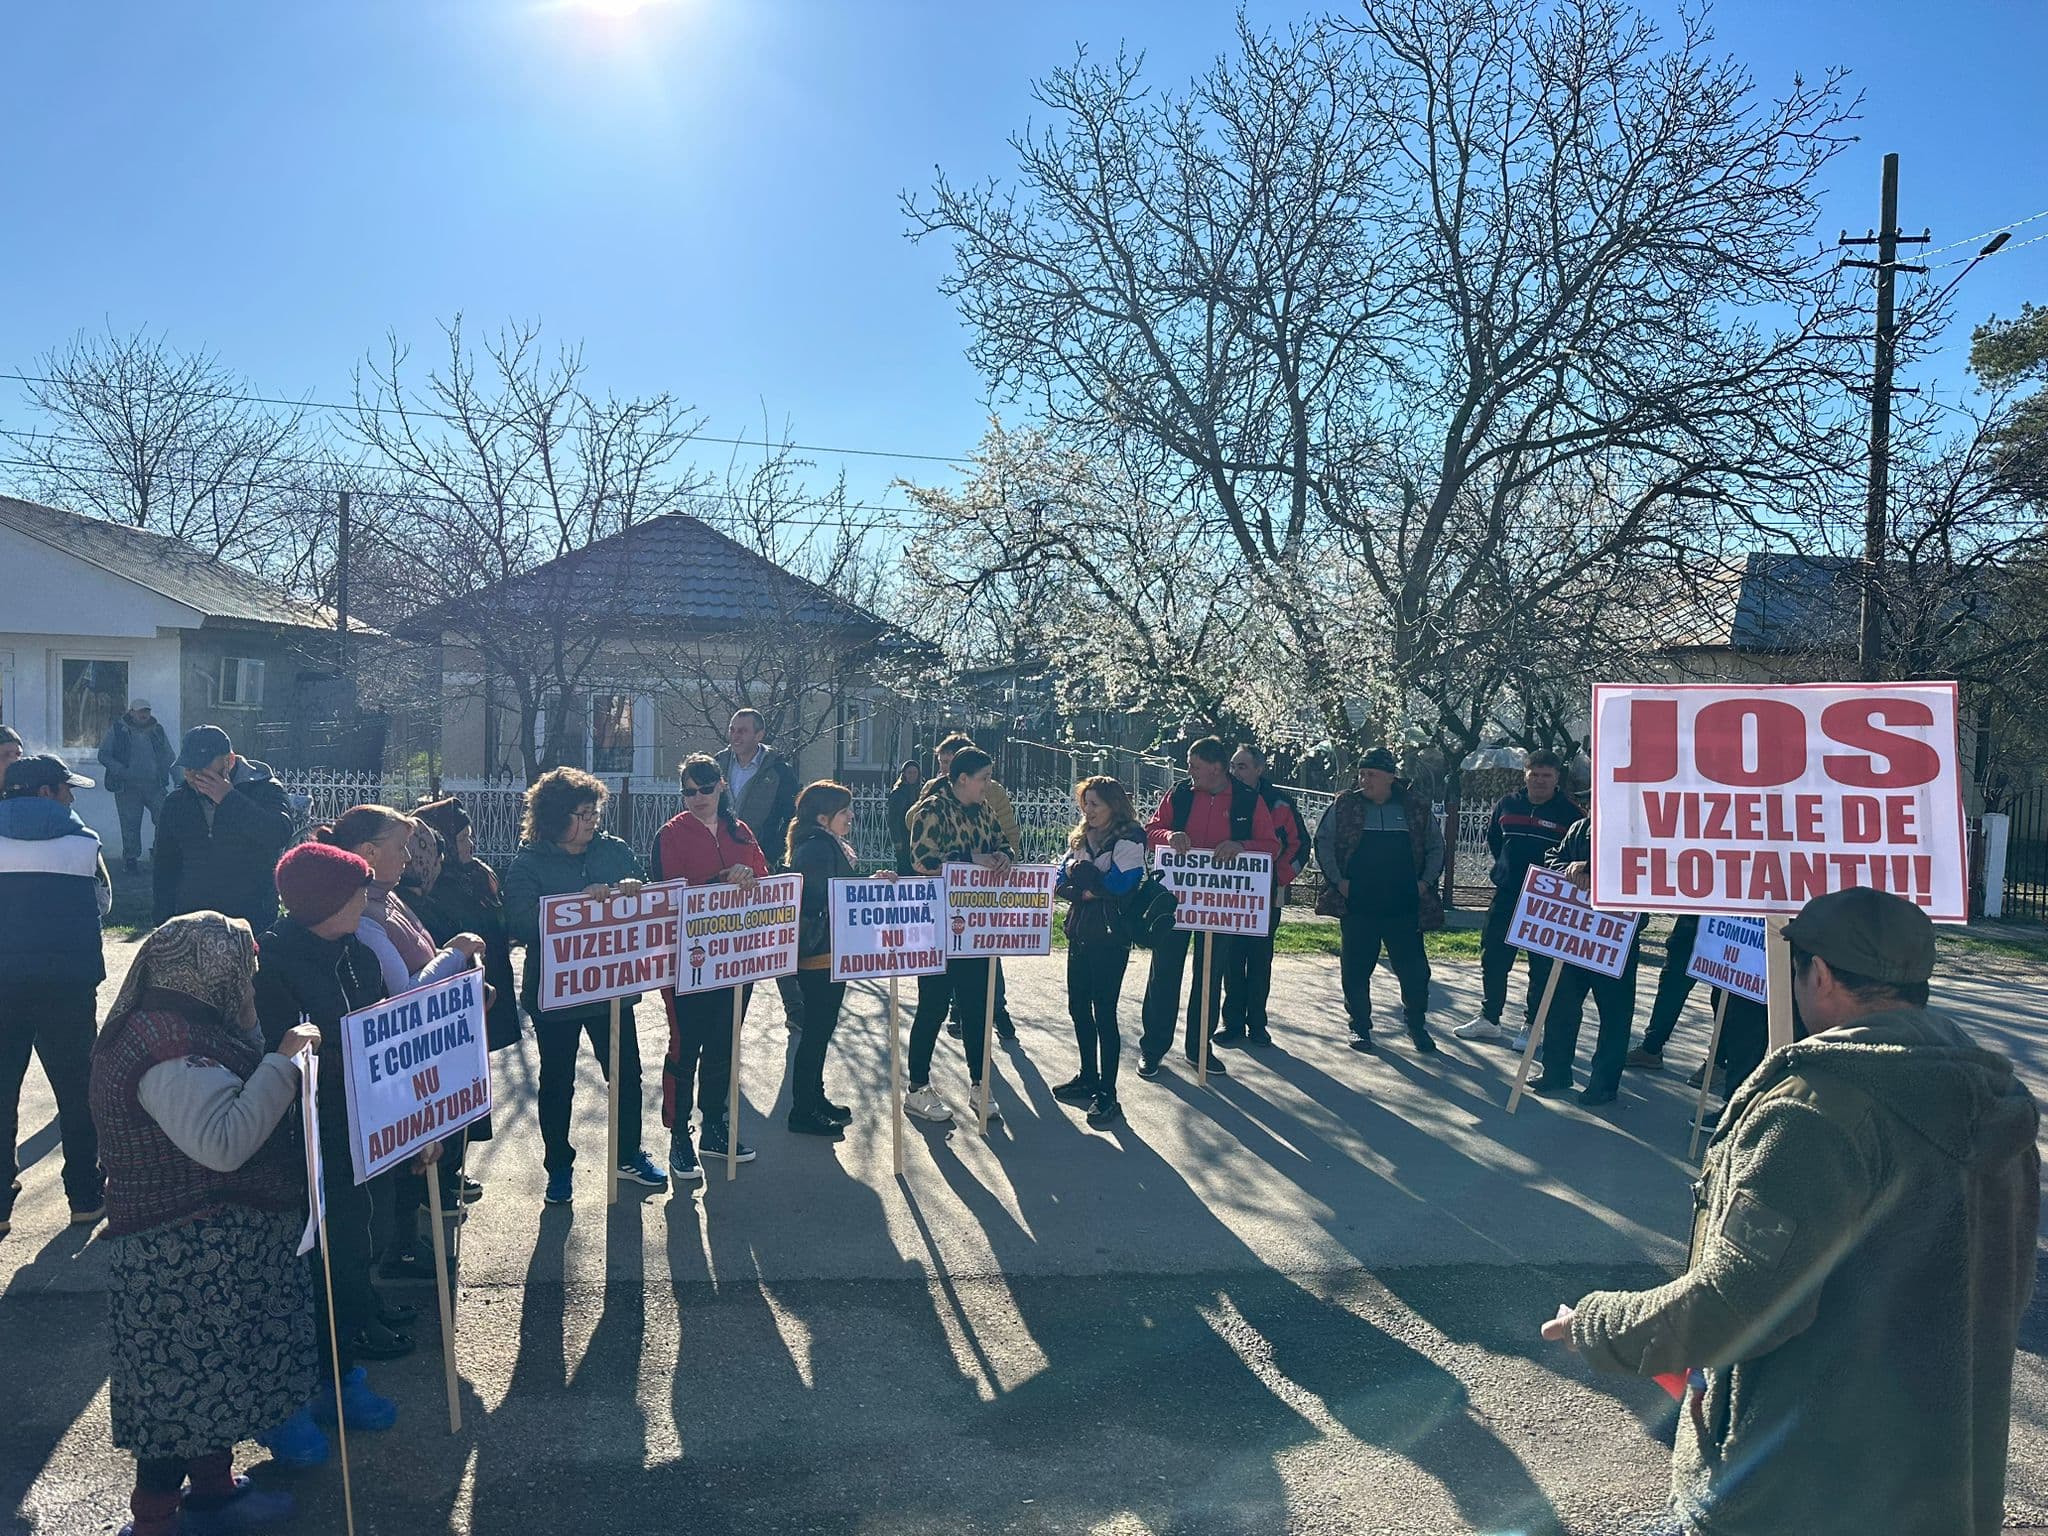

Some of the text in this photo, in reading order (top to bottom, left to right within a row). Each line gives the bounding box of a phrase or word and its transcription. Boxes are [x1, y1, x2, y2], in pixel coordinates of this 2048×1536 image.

[1613, 698, 1941, 789] JOS
[1643, 791, 1918, 845] VIZELE DE
[1161, 852, 1268, 873] GOSPODARI
[846, 880, 937, 903] BALTA ALBĂ
[950, 870, 967, 887] NE
[687, 894, 705, 915] NE
[949, 892, 1049, 909] VIITORUL COMUNEI
[1169, 890, 1265, 913] U PRIMIȚI
[686, 905, 796, 938] VIITORUL COMUNEI
[849, 903, 935, 926] E COMUNĂ,
[968, 912, 1048, 928] CU VIZELE DE
[1176, 909, 1257, 931] LOTANȚI!
[1526, 896, 1627, 942] VIZELE DE
[1708, 918, 1715, 934] E
[553, 923, 677, 963] VIZELE DE
[708, 927, 795, 957] CU VIZELE DE
[882, 929, 904, 947] NU
[973, 933, 1040, 950] FLOTANT!!!
[1517, 921, 1619, 967] FLOTANT!
[715, 952, 788, 980] FLOTANT!!!
[839, 947, 943, 974] ADUNĂTURĂ!
[1723, 944, 1740, 963] NU
[1692, 956, 1766, 995] ADUNĂTURĂ!
[363, 977, 474, 1048] BALTA ALBĂ
[369, 1017, 475, 1084] E COMUNĂ,
[412, 1066, 441, 1102] NU
[368, 1078, 488, 1163] ADUNĂTURĂ!
